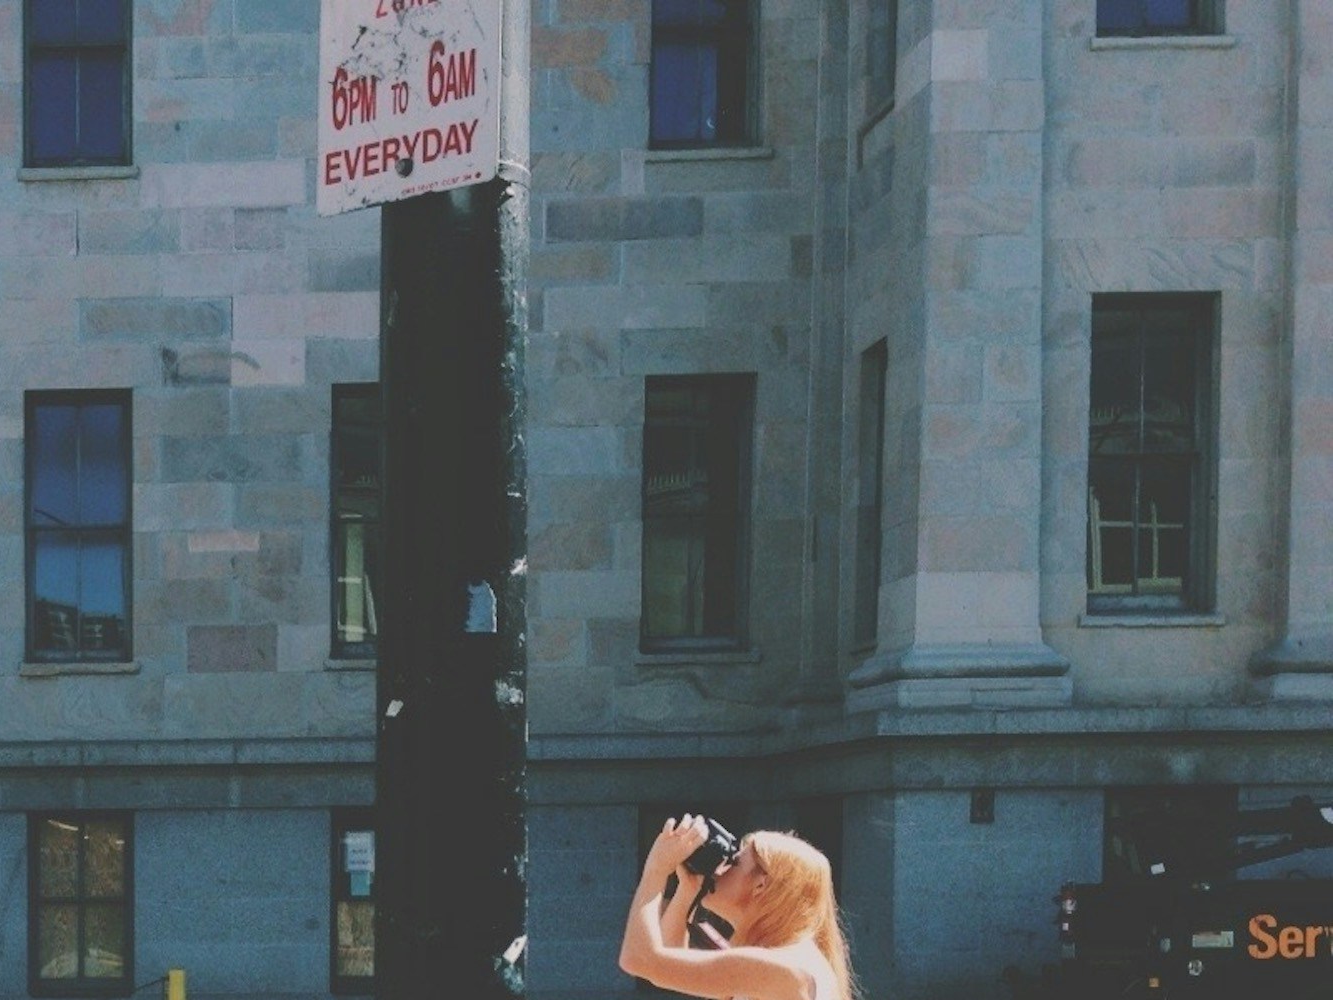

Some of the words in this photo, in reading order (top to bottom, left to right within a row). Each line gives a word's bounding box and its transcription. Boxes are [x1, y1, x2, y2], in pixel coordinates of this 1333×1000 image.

[331, 66, 377, 131] 6PM
[391, 81, 409, 116] TO
[427, 39, 477, 107] 6AM
[324, 118, 479, 186] EVERYDAY
[1247, 913, 1333, 960] Ser
